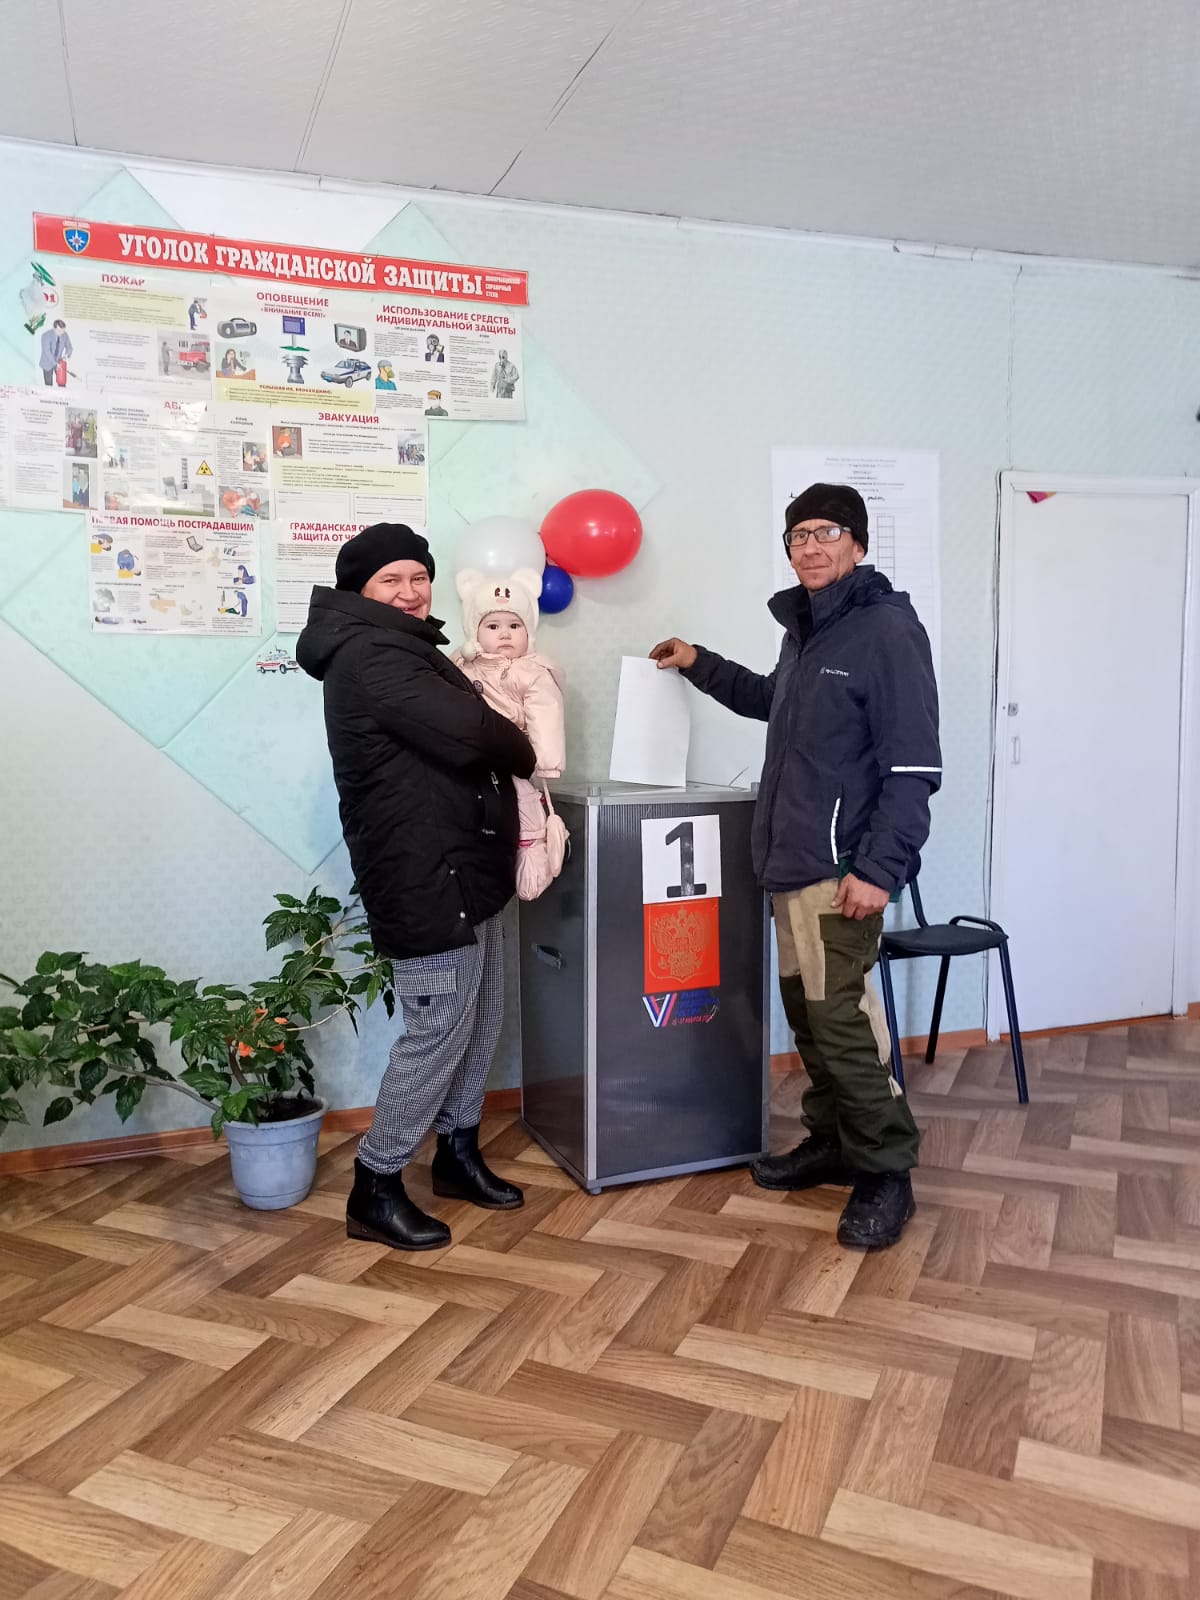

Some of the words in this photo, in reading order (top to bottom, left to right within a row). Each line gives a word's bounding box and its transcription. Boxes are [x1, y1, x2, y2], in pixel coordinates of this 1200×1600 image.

[118, 233, 208, 265] УГОЛОК
[215, 245, 376, 286] ГРАЖДАНСКОЙ
[383, 265, 482, 296] ЗАЩИТЫ
[101, 274, 145, 286] ПОЖАР
[256, 292, 329, 307] ОПОВЕЩЕНИЕ
[382, 304, 469, 322] ИСПОЛЬЗОВАНИЕ
[471, 313, 510, 325] СРЕДСТВ
[376, 315, 473, 333] ИНДИВИДУАЛЬНОЙ
[474, 323, 516, 336] ЗАЩИТЫ
[318, 412, 380, 425] ЭВАКУАЦИЯ
[130, 517, 176, 528] ПОМОЩЬ
[178, 520, 254, 532] ПОСТРАДАВШИМ
[290, 522, 357, 532] ГРАЖДАНСКАЯ
[292, 532, 330, 542] ЗАЩИТА
[332, 534, 343, 542] ОТ
[665, 821, 707, 898] 1
